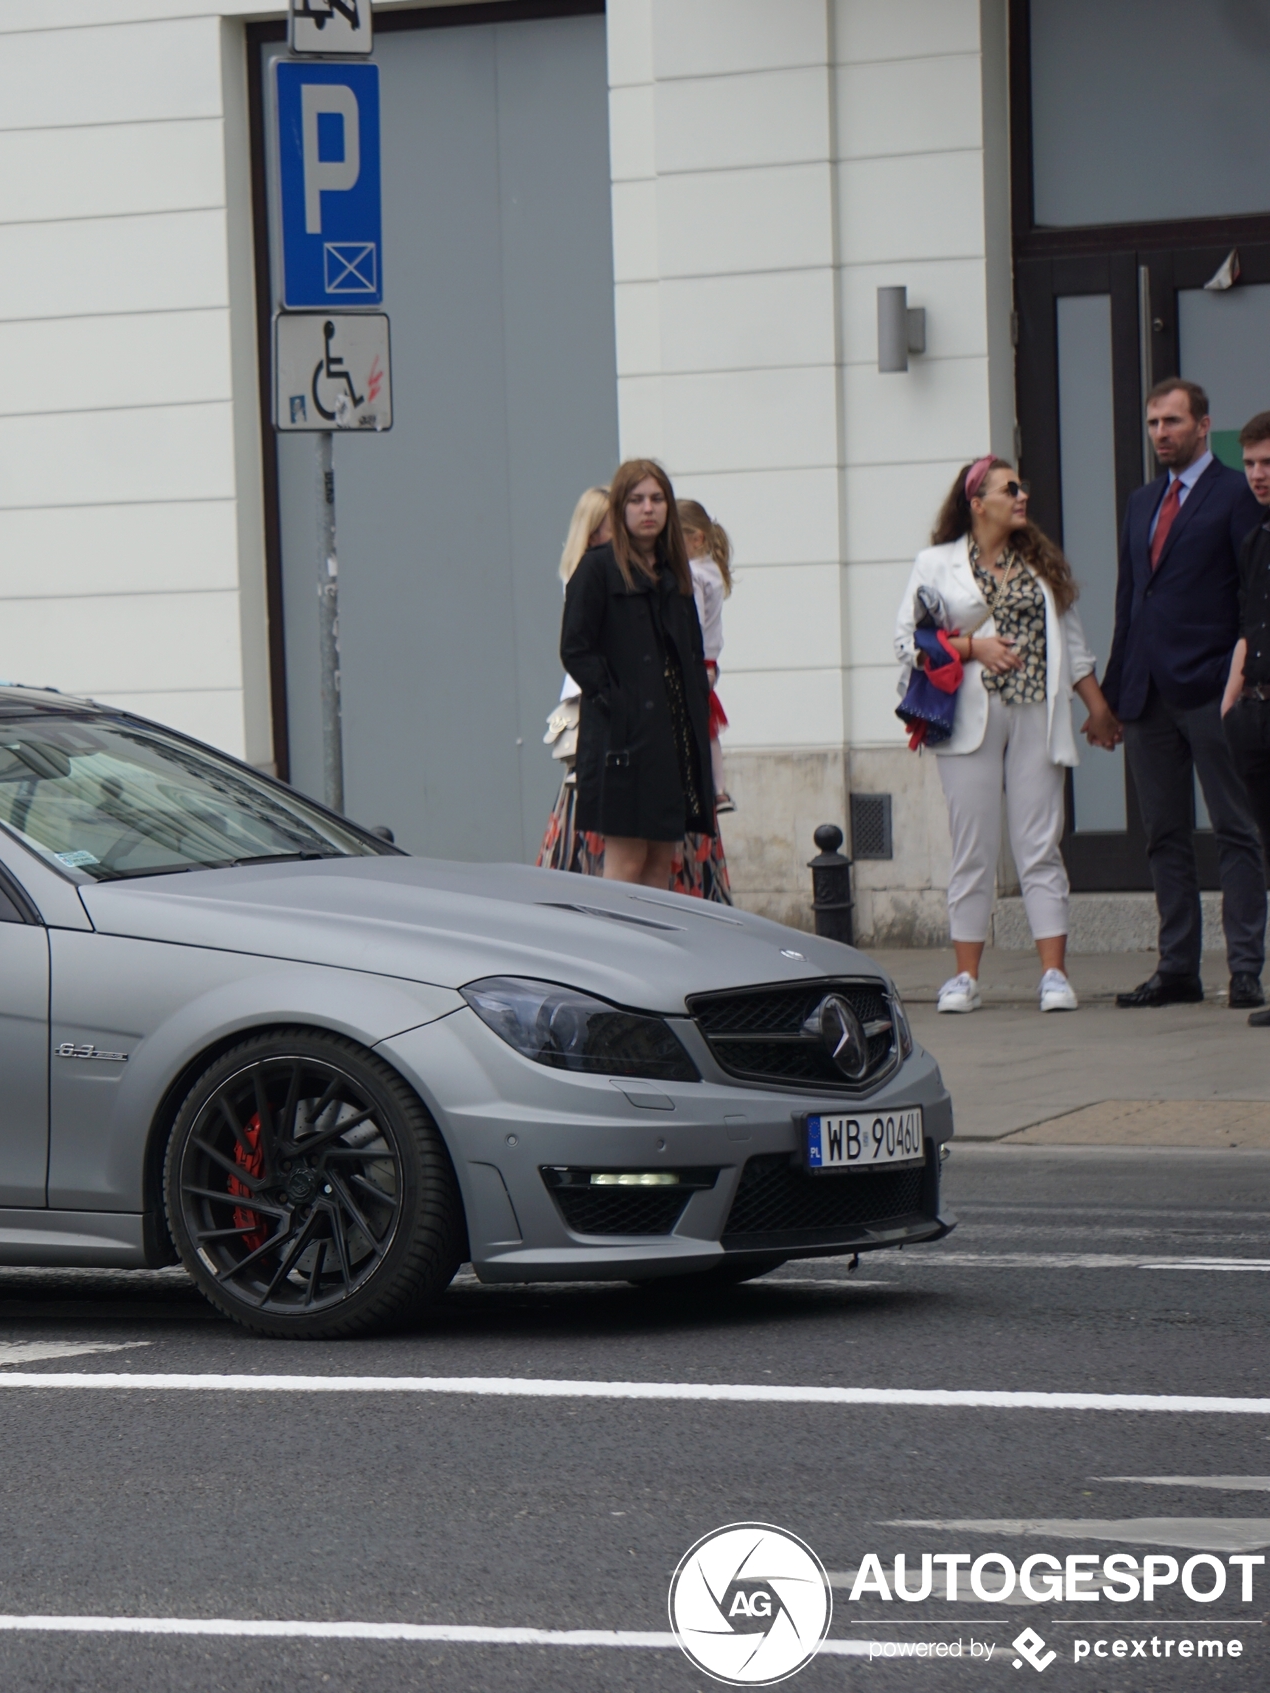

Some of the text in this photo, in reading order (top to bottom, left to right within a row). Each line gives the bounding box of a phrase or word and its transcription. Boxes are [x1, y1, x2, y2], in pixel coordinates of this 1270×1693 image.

[301, 84, 360, 234] P
[59, 1043, 94, 1058] 6.3
[810, 1147, 821, 1158] PL
[827, 1113, 919, 1161] WB 9046U
